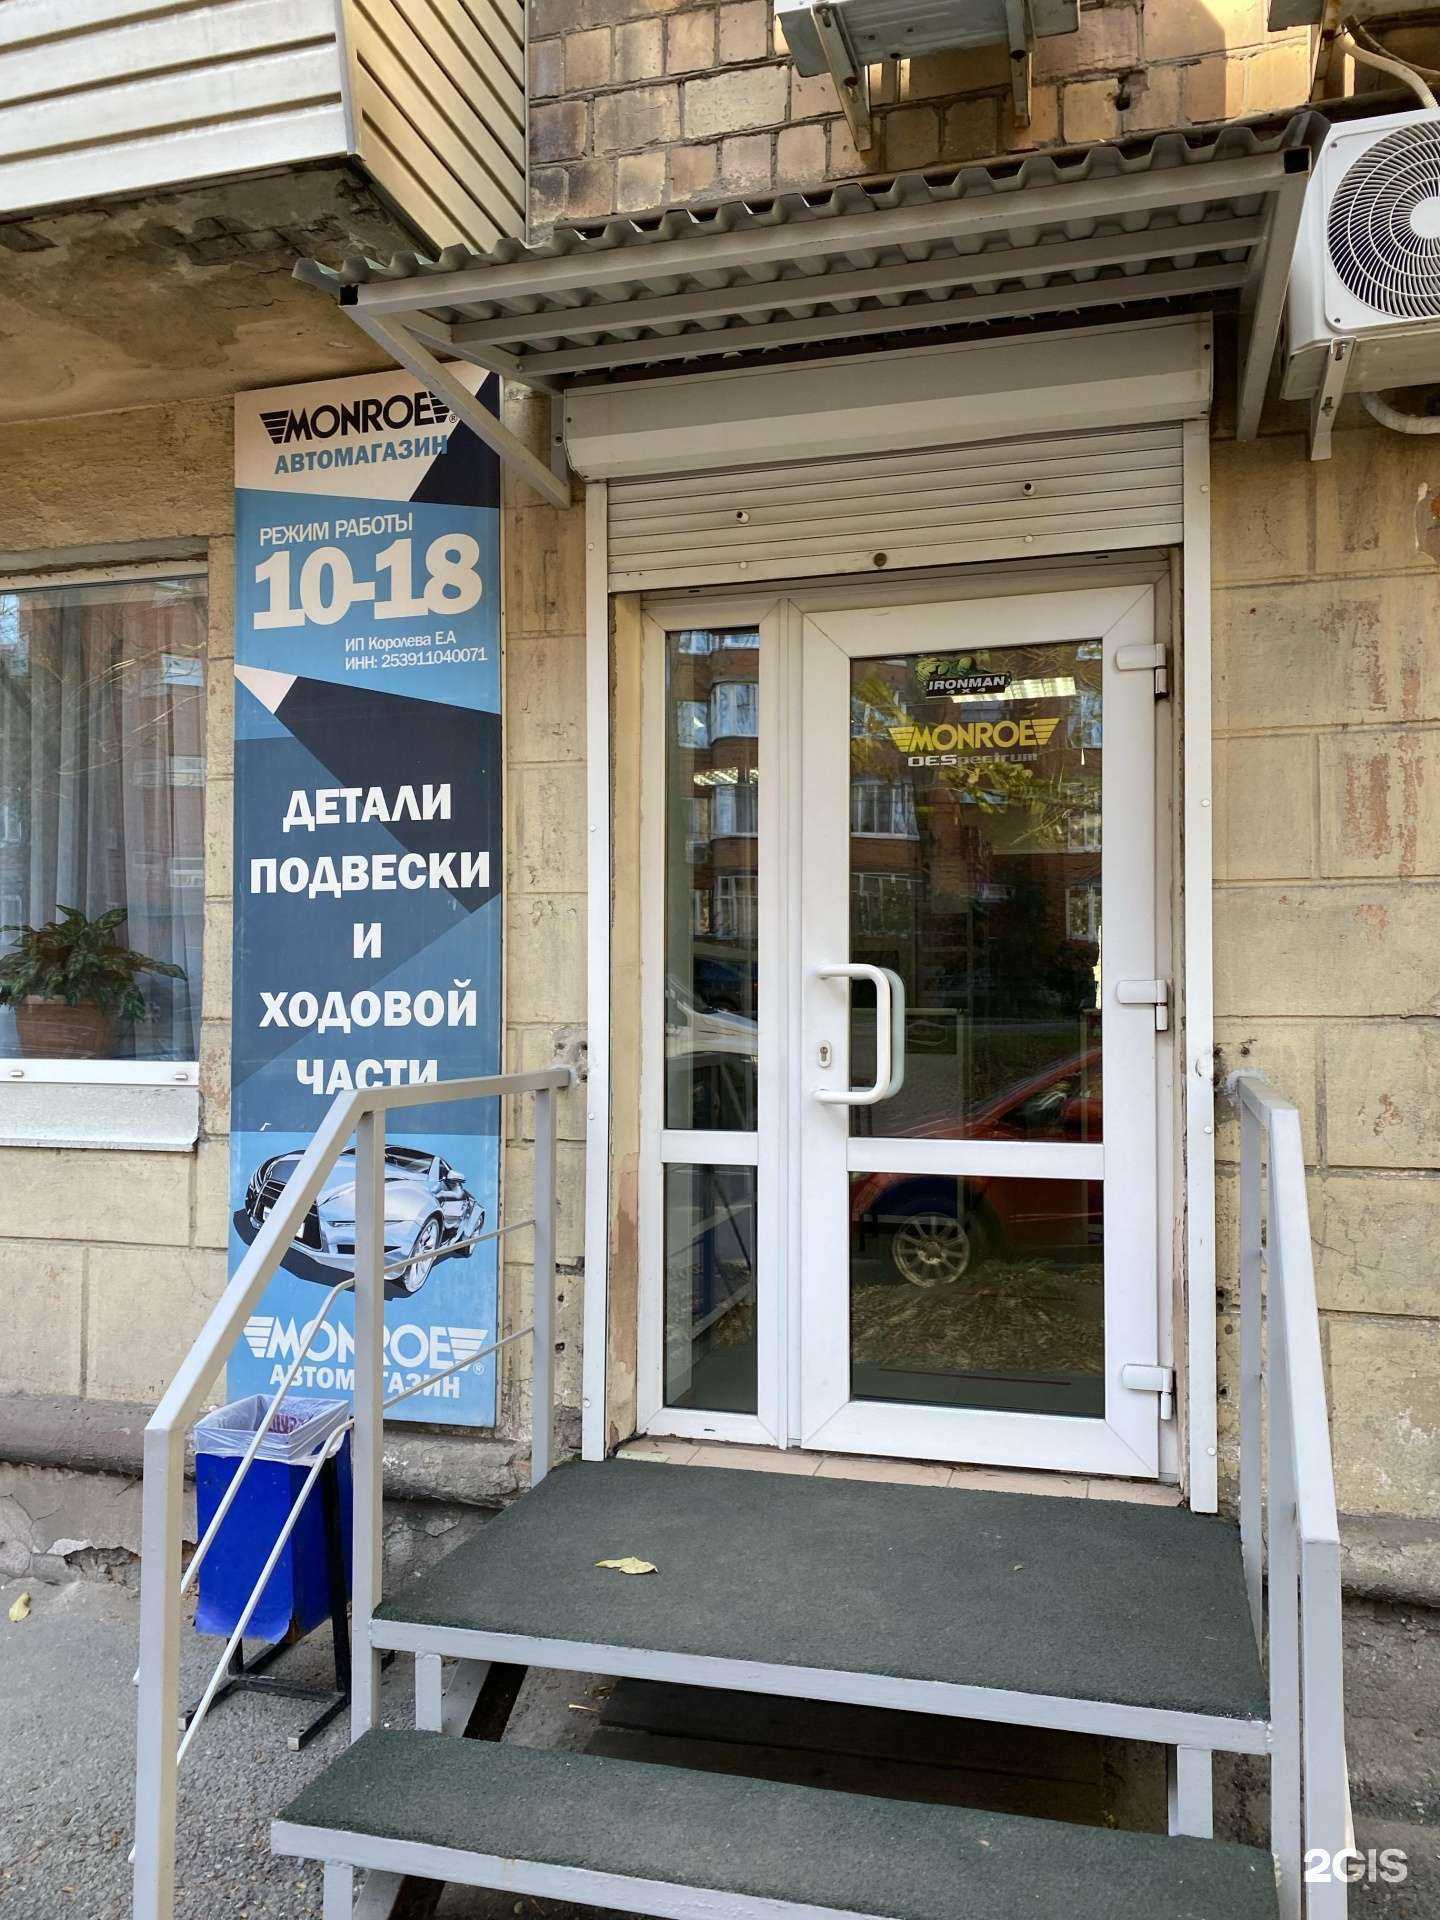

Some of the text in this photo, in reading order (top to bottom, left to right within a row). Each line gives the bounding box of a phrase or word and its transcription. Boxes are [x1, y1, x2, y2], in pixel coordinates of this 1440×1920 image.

[284, 391, 434, 444] MONROE
[275, 435, 448, 474] АВТОМАГАЗИН
[260, 512, 413, 546] РЕЖИМ РАБОТЫ
[253, 533, 483, 630] 10-18
[345, 638, 364, 651] ИП
[368, 634, 431, 650] Королева
[345, 647, 488, 671] ИНН: 253911040071
[928, 676, 1005, 691] IRONMAN
[909, 719, 1037, 752] MONROE
[282, 783, 451, 832] ДЕТАЛИ
[250, 852, 490, 899] ПОДВЕСКИ
[353, 922, 382, 959] И
[259, 978, 477, 1033] ХОДОВОЙ
[296, 1058, 438, 1095] ЧАСТИ
[265, 1315, 455, 1370] MONOE
[269, 1363, 460, 1399] АВТОМАЗИН
